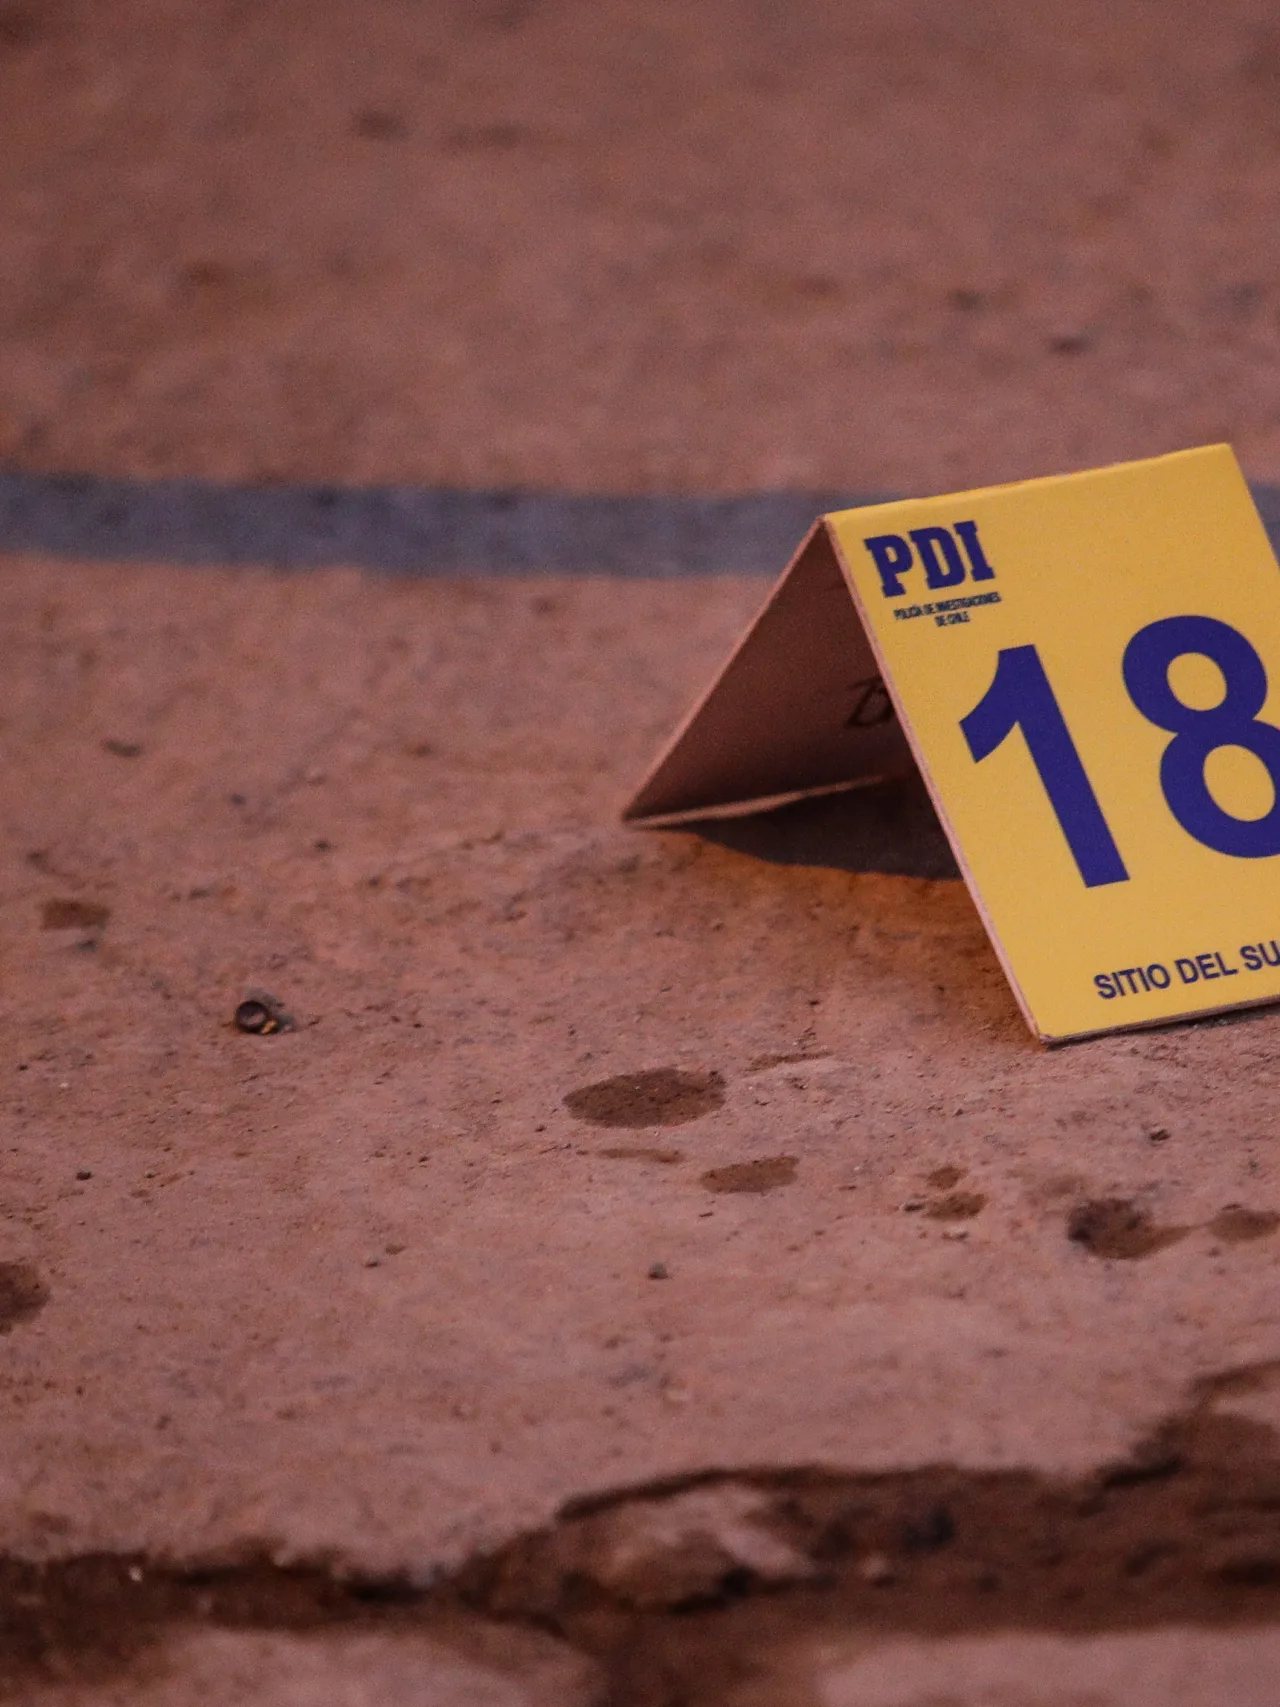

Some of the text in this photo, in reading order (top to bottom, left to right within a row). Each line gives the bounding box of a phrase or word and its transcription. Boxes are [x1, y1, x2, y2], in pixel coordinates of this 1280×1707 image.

[863, 520, 996, 598] PDI
[1094, 963, 1171, 999] SITIO
[1175, 952, 1238, 984] DEL
